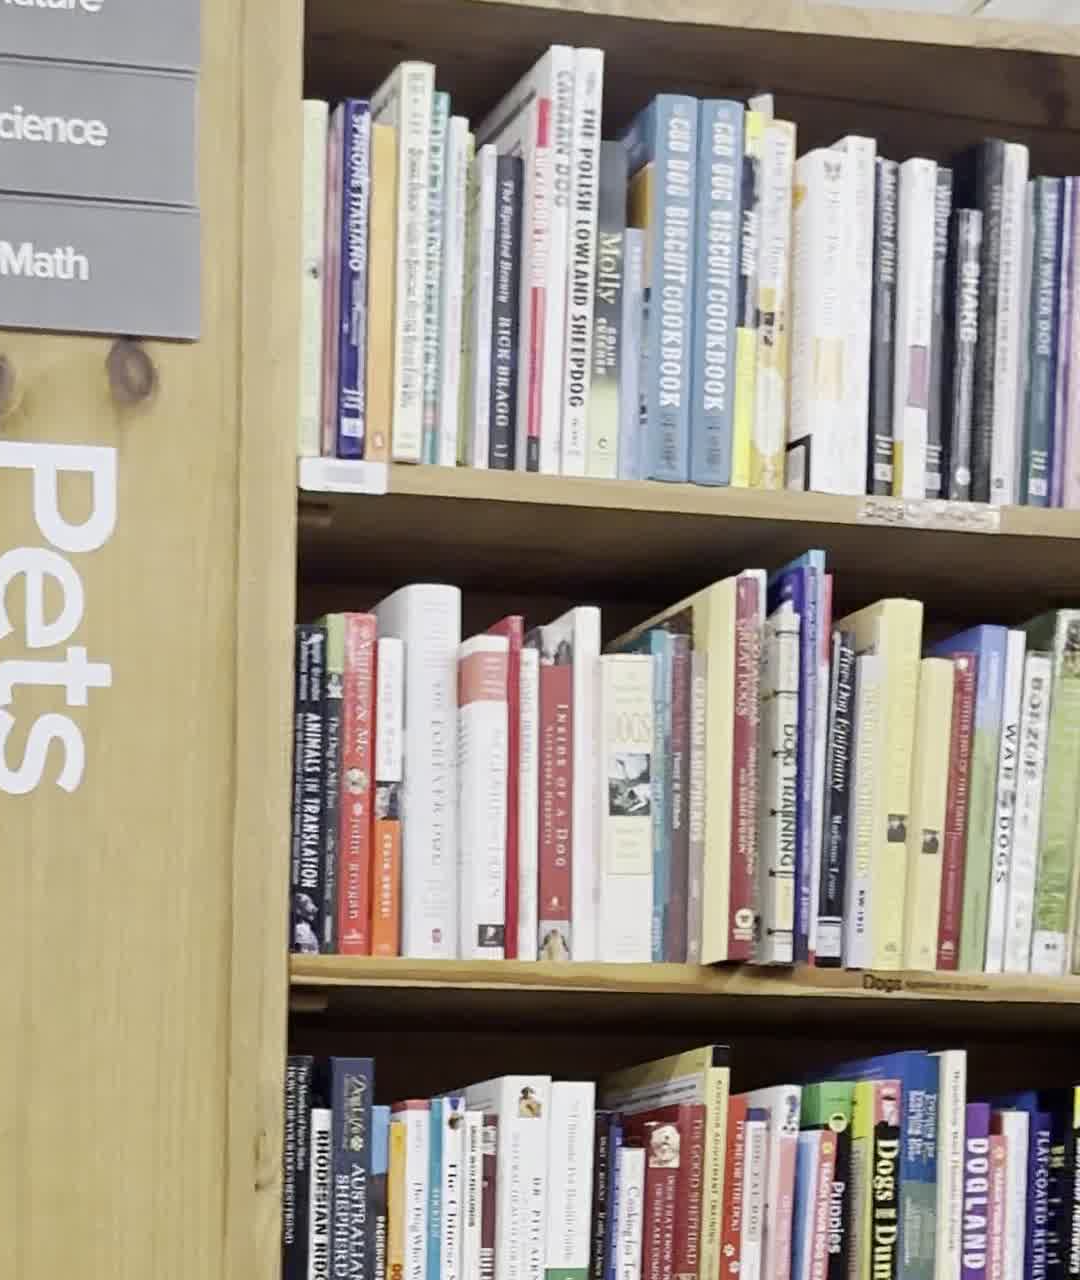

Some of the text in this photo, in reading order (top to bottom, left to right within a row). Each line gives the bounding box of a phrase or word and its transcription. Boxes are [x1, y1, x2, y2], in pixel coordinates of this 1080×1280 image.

[569, 108, 596, 407] THE POLISH LOWLAND SHEEPDOG
[597, 231, 622, 304] Molly
[663, 206, 688, 284] BISCUIT
[707, 210, 731, 288] BISCUIT
[659, 286, 684, 408] COOKBOOK
[703, 289, 730, 411] COOKBOOK
[302, 712, 319, 775] ANIMALS
[300, 798, 318, 888] TRANSLATION
[996, 816, 1012, 884] DOGS
[863, 974, 903, 993] Dogs
[314, 1130, 330, 1235] RHODESIAN
[689, 1149, 702, 1188] GOOD
[873, 1138, 898, 1201] Dogs
[963, 1138, 989, 1270] DOGLAND
[1034, 1130, 1050, 1224] FLAT-COATED
[334, 1174, 350, 1277] SHEPHERD
[446, 1200, 457, 1274] Chinese
[623, 1186, 639, 1237] Cooking
[827, 1182, 845, 1254] Puppies
